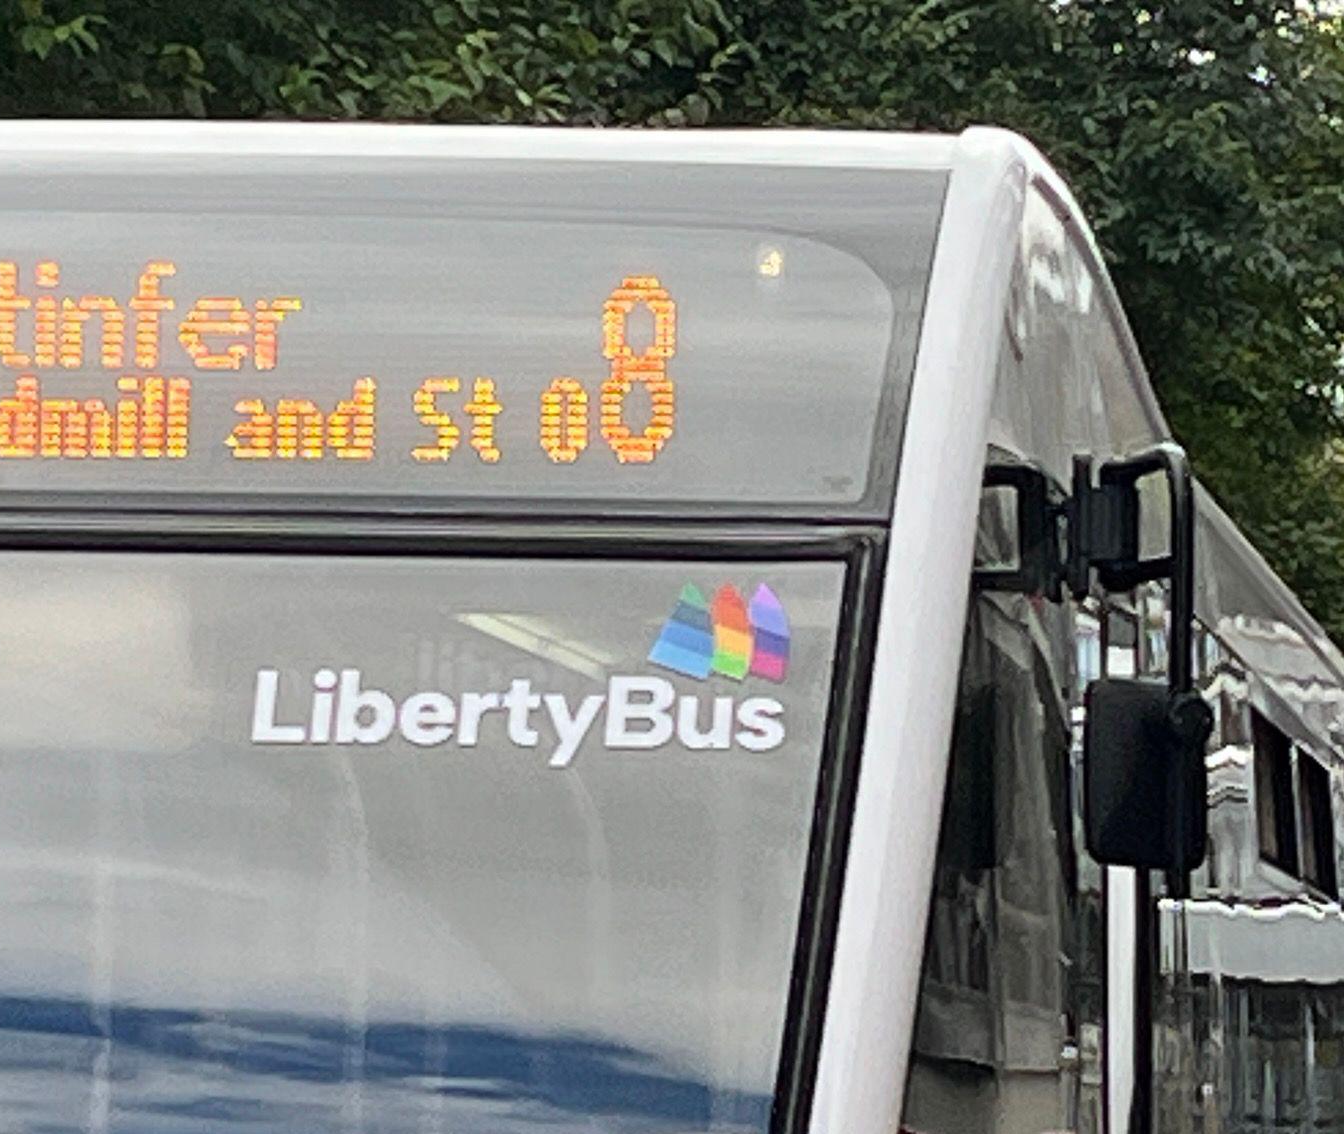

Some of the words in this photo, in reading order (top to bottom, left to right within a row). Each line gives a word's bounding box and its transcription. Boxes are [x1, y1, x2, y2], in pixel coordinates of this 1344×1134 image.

[600, 275, 676, 462] 8
[224, 376, 375, 459] and
[410, 376, 503, 462] St
[251, 668, 787, 767] LibertyBus
